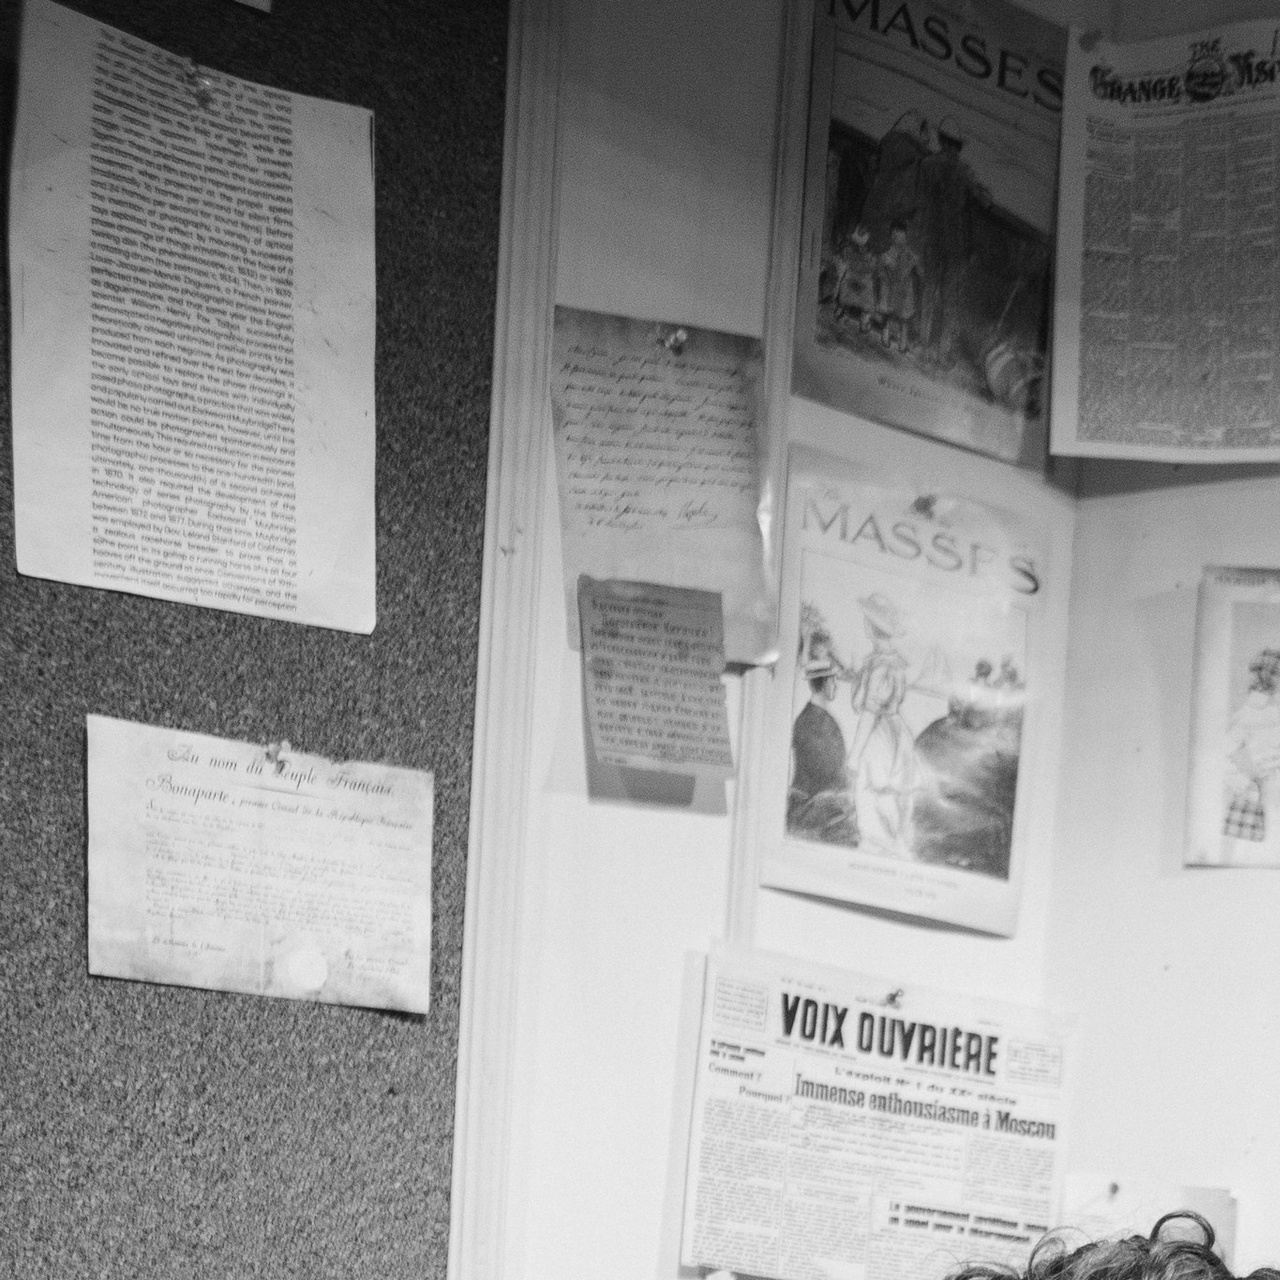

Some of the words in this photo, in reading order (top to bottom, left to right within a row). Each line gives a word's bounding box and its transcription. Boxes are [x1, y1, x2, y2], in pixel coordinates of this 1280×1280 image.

[781, 992, 849, 1050] VOIX
[857, 1011, 999, 1076] OUVRIÈRE
[795, 1073, 866, 1109] Immense
[869, 1093, 979, 1129] enthousiasme
[982, 1108, 991, 1130] à
[995, 1110, 1057, 1140] Moscou
